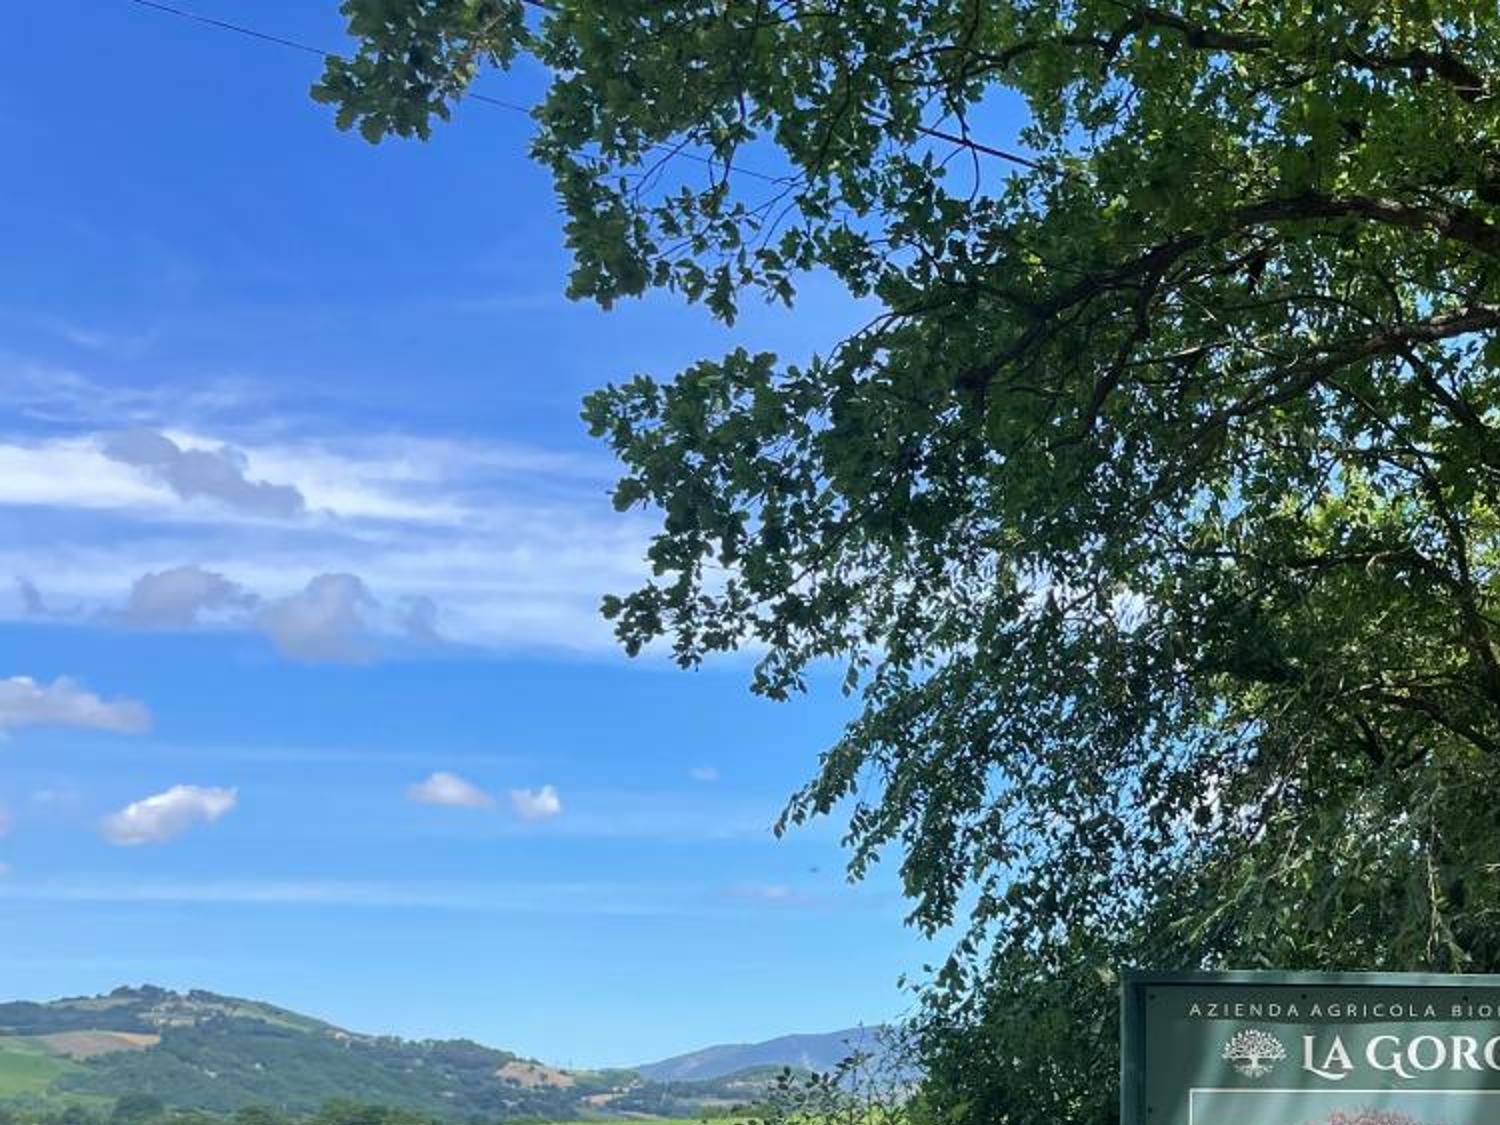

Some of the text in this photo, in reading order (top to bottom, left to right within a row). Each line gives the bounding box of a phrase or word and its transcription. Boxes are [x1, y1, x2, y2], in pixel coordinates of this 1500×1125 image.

[1188, 1003, 1300, 1018] AZIENDA
[1310, 1004, 1437, 1018] AGRICOLA
[1301, 1035, 1353, 1081] LA
